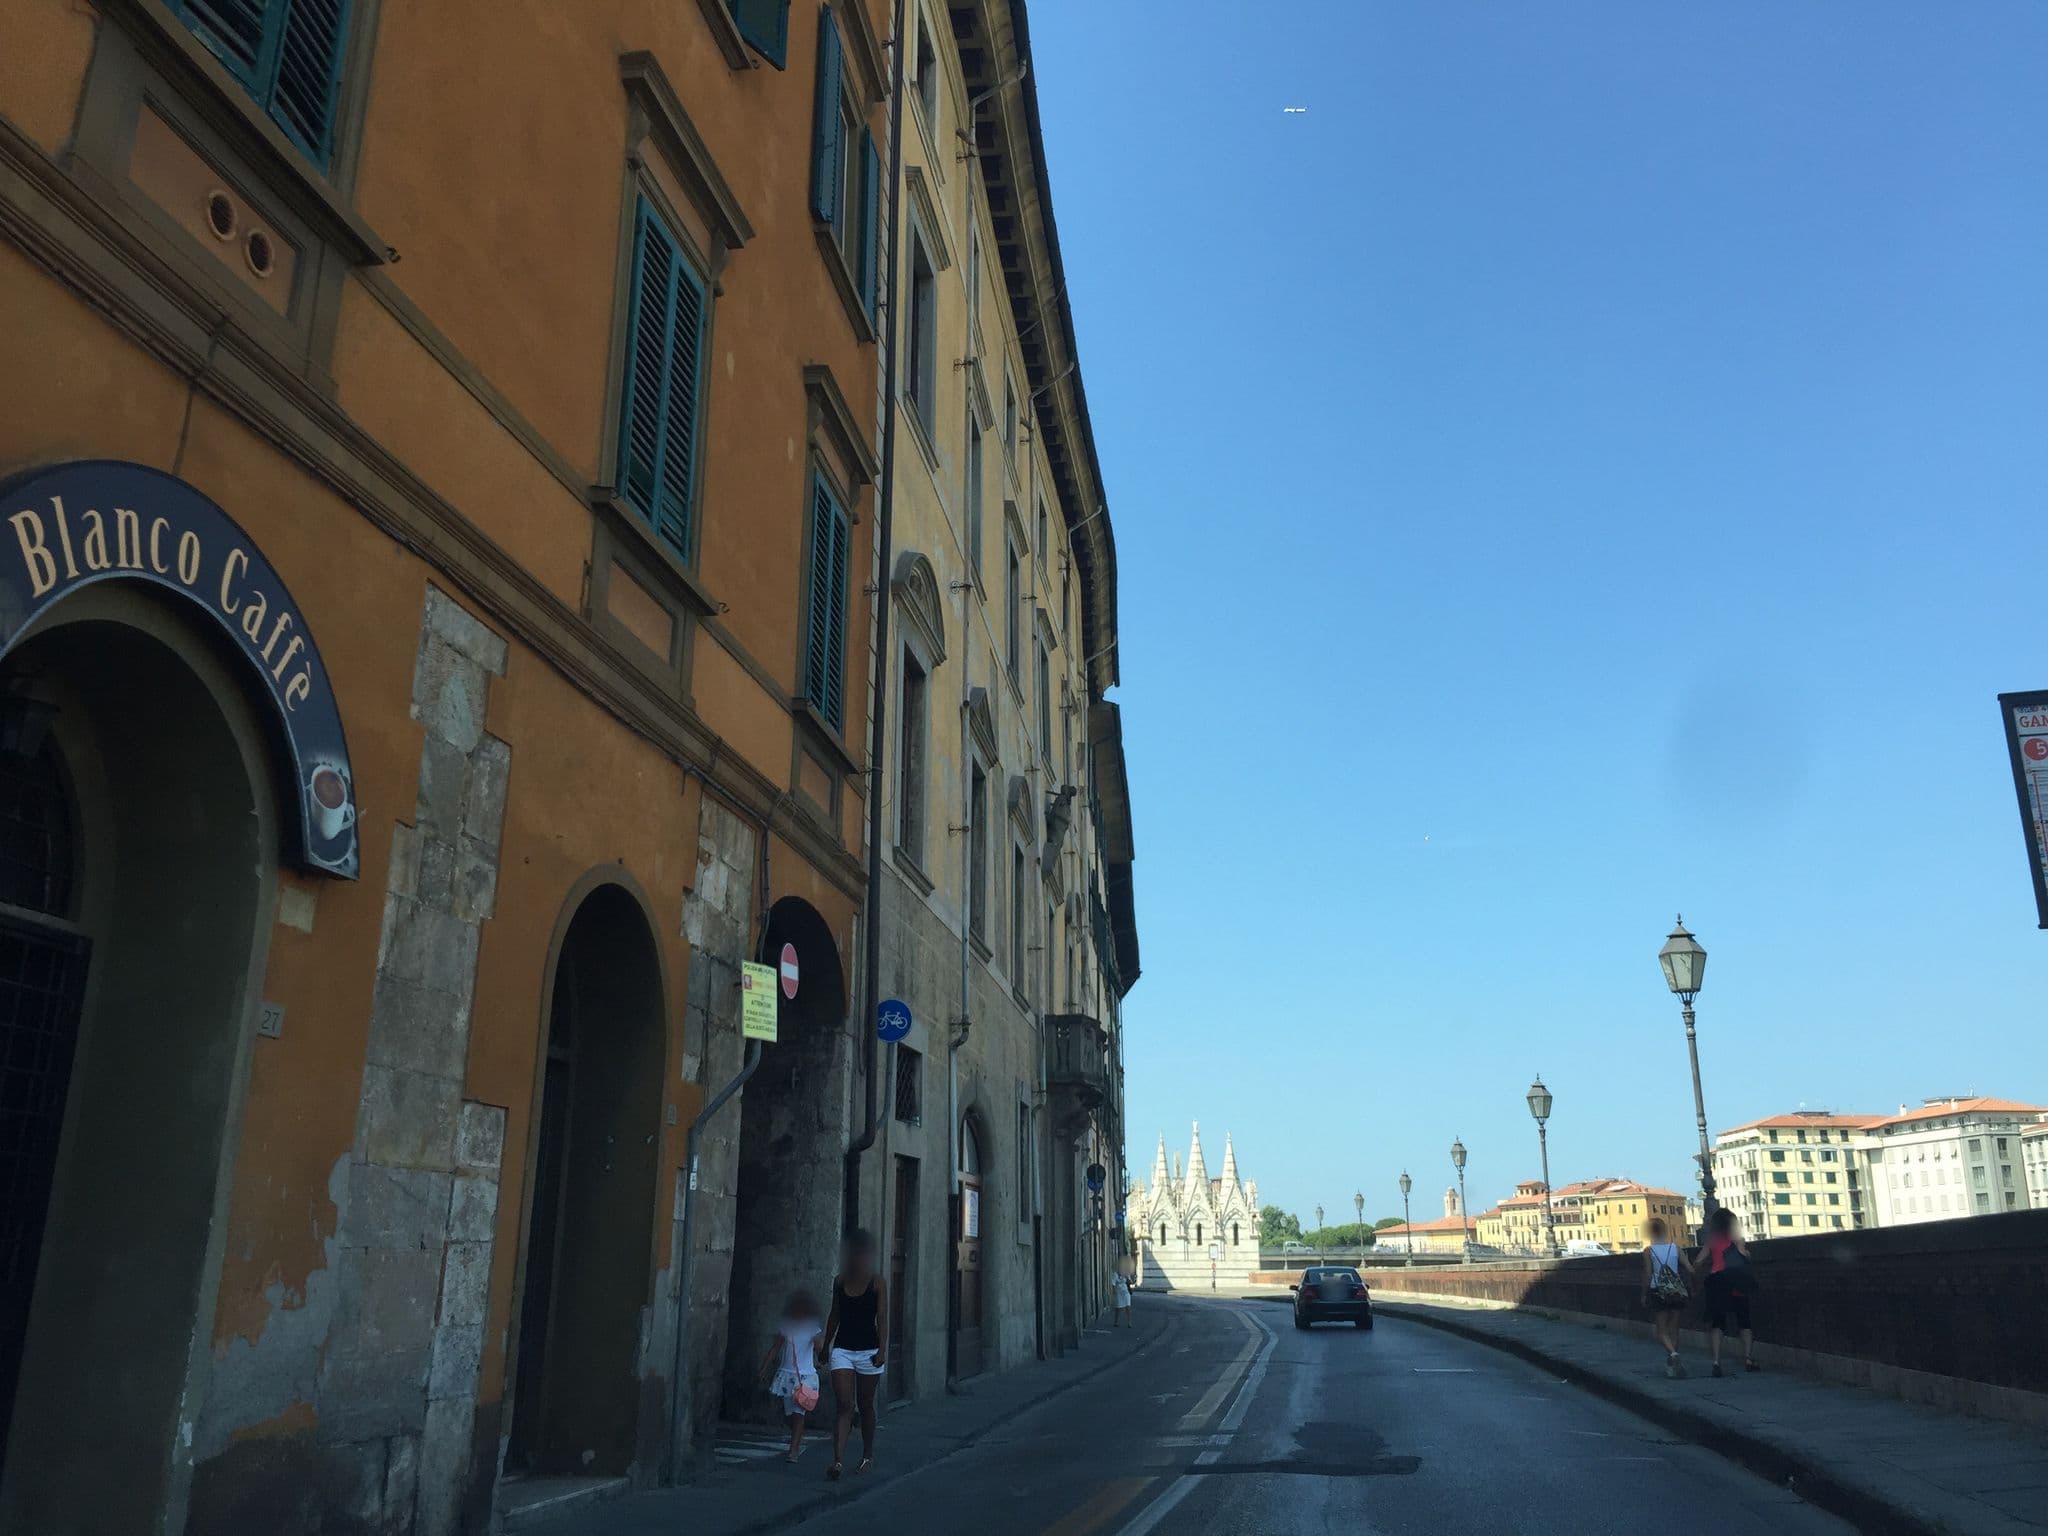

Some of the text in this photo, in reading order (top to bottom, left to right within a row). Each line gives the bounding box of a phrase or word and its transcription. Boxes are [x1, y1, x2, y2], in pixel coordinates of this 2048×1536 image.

[8, 496, 311, 712] Blanco Caffè
[261, 1010, 280, 1032] 27
